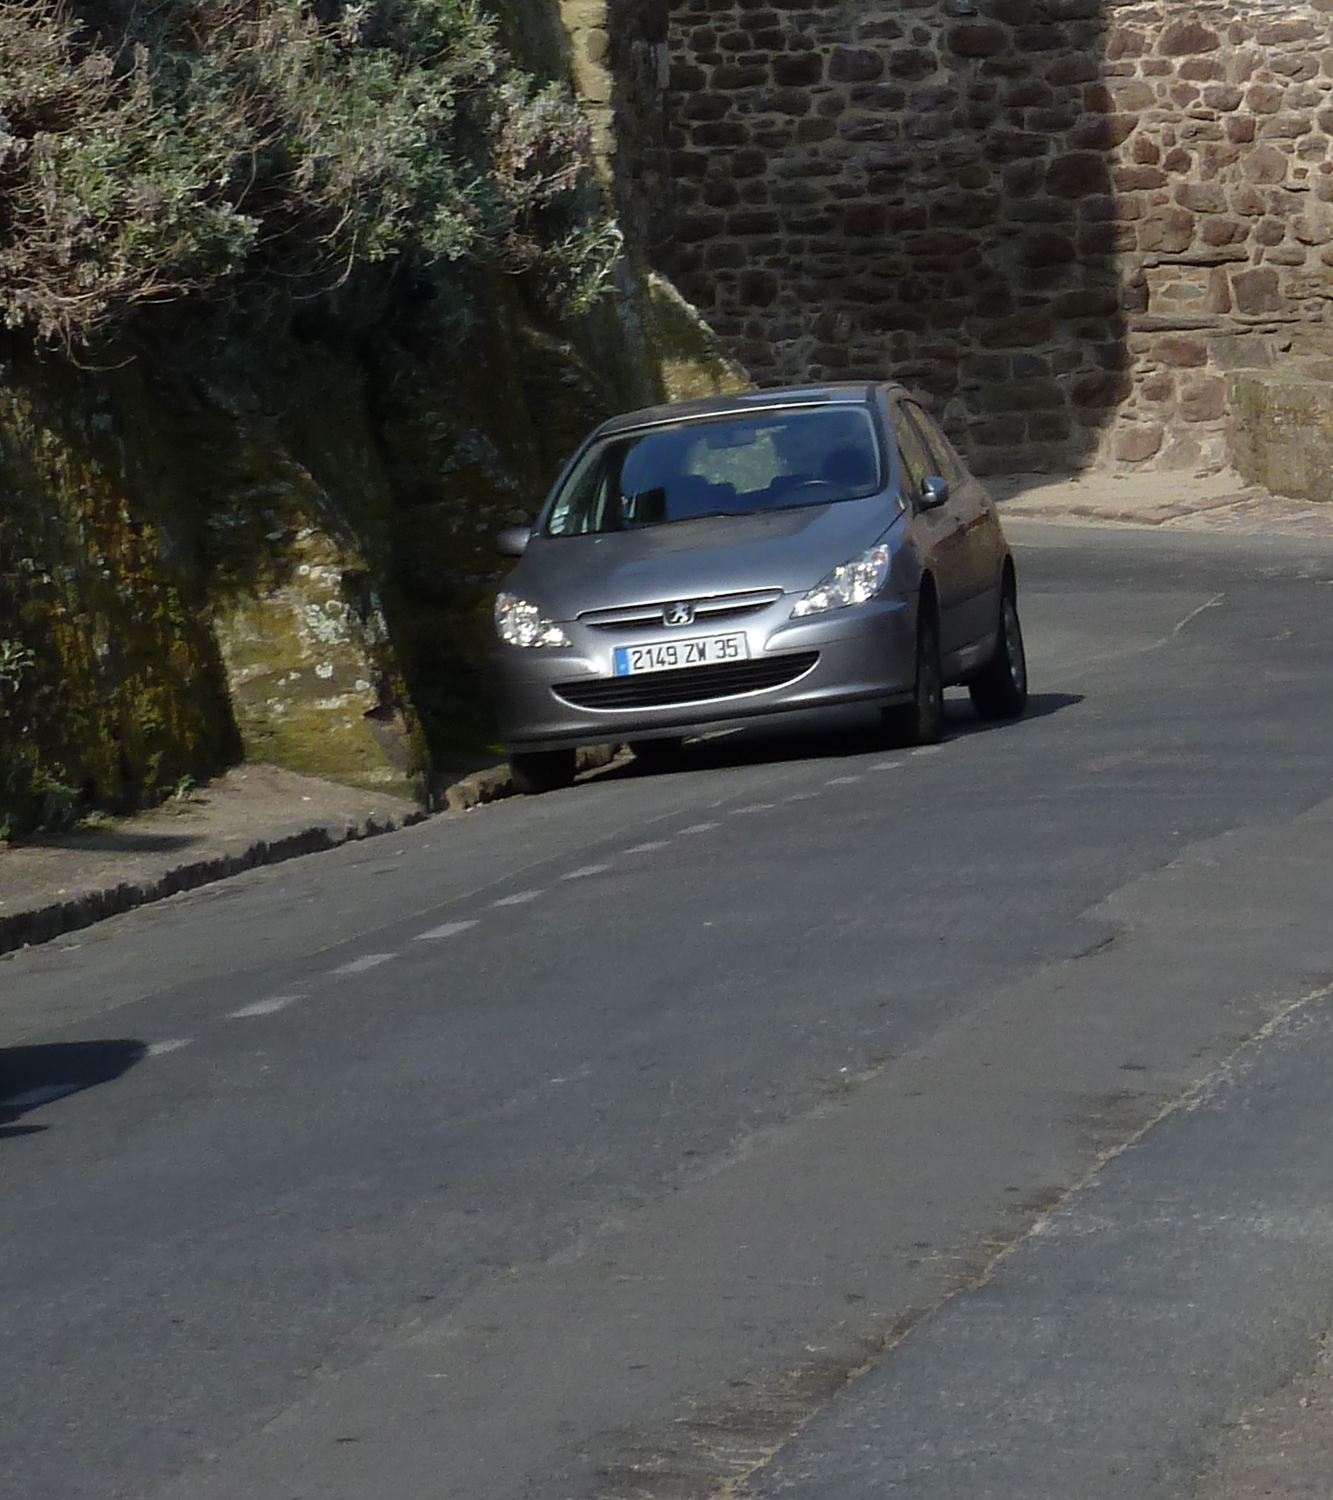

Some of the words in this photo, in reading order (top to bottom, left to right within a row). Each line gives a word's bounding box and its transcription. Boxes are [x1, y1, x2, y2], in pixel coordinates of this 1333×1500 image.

[632, 646, 678, 670] 2149
[684, 642, 707, 663] ZW
[714, 638, 739, 659] 35
